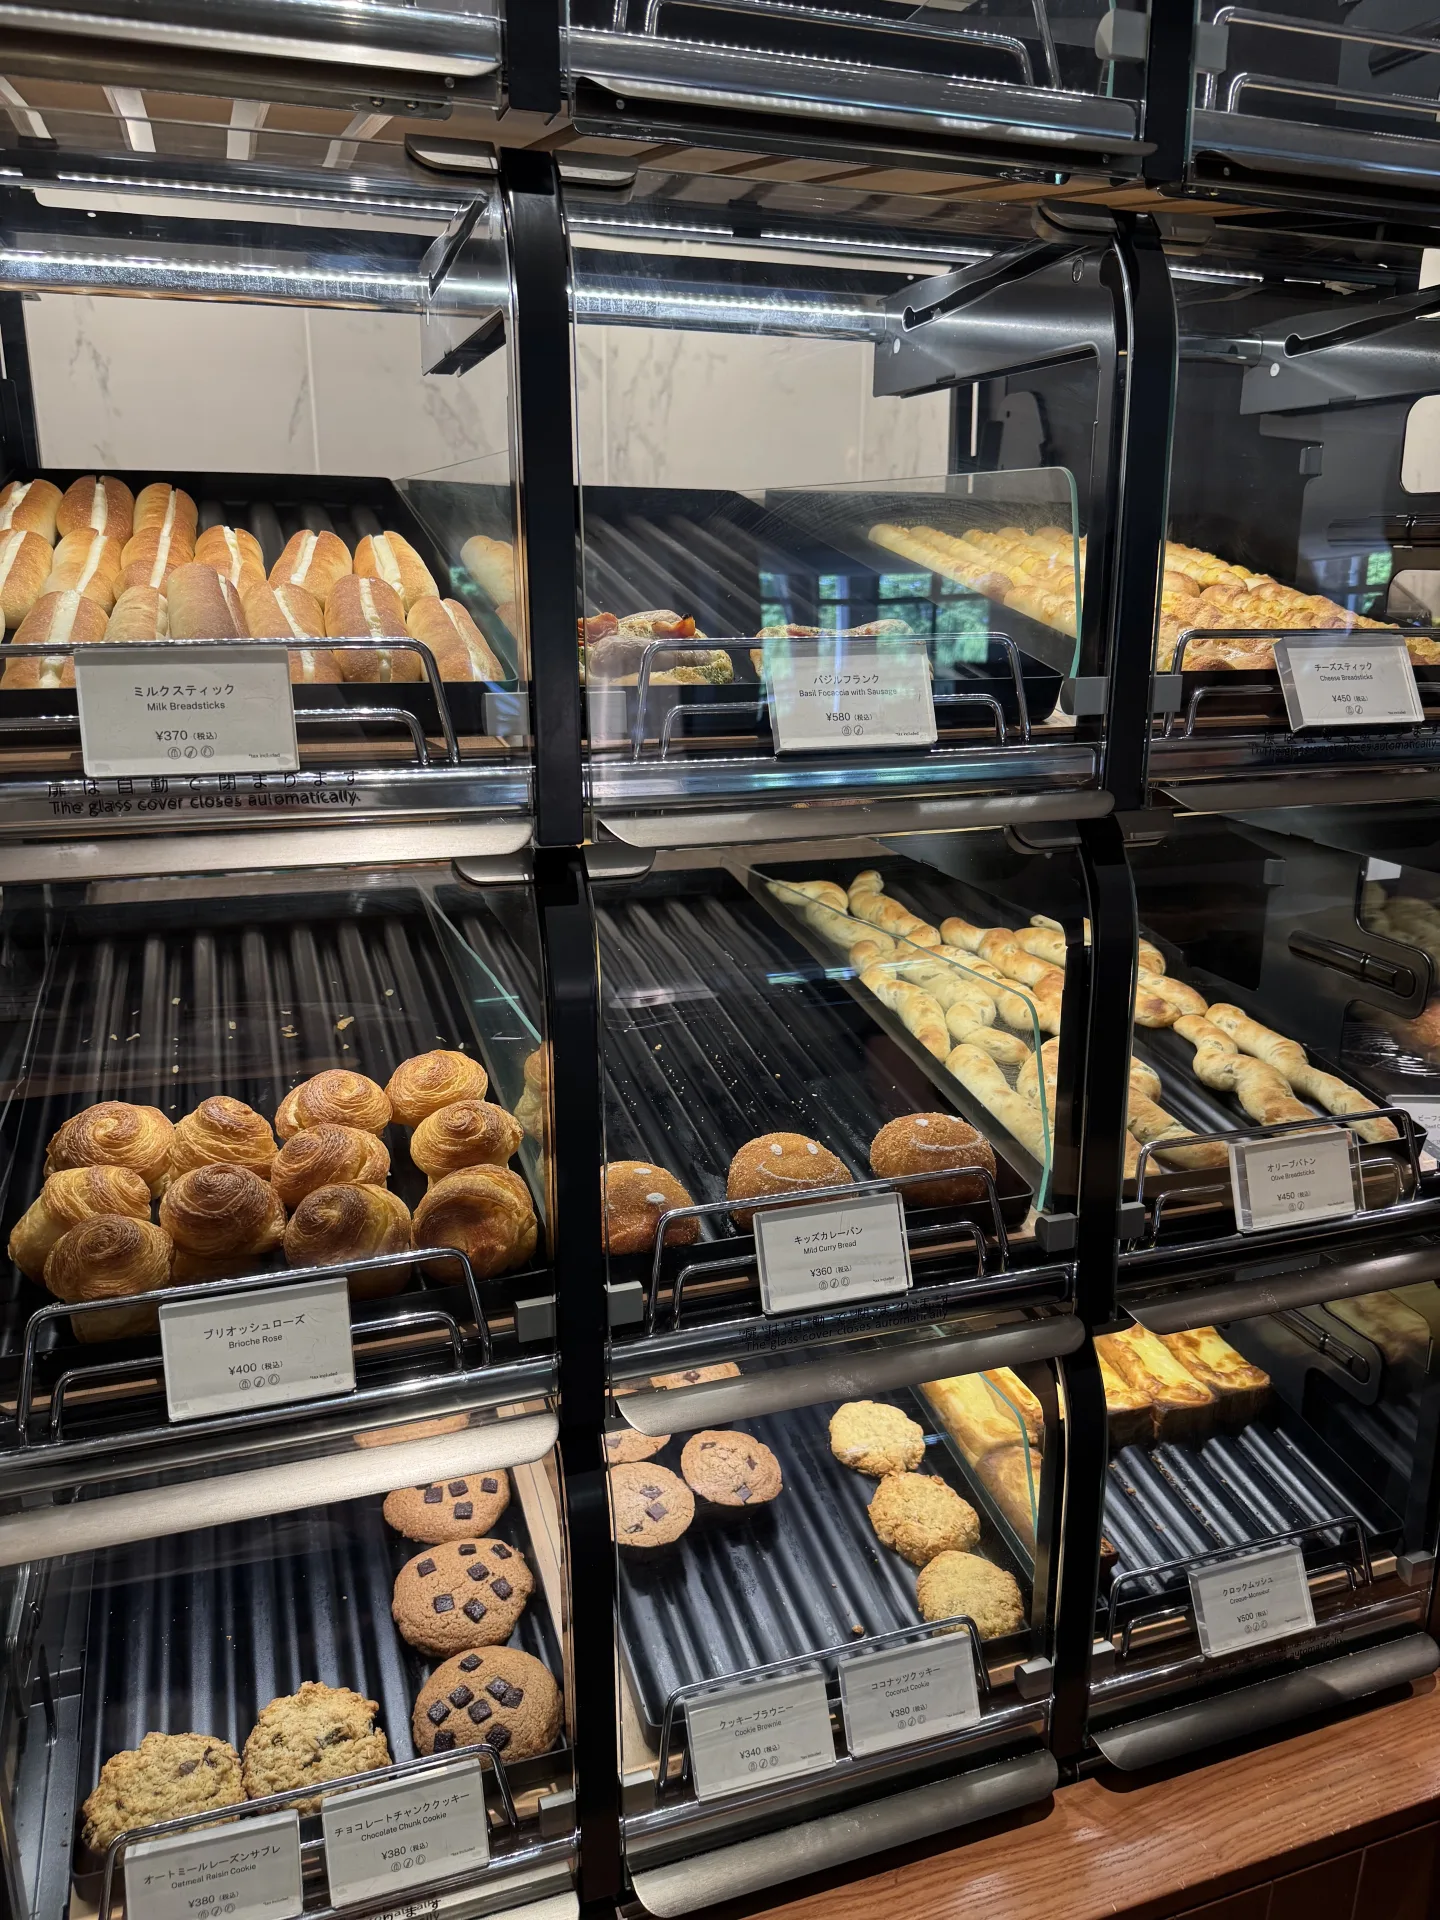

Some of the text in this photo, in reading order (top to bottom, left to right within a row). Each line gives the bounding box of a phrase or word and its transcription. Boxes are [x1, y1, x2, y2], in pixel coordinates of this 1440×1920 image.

[813, 674, 880, 685] バジルフランク
[1341, 674, 1373, 682] Breadsticks
[134, 683, 234, 697] ミルクスティック
[799, 689, 817, 697] Basil
[818, 689, 850, 697] Focaccia
[867, 688, 897, 696] Sausage
[147, 701, 225, 711] Milk Breadsticks
[826, 712, 851, 721] ¥580
[155, 730, 188, 741] ¥370
[49, 800, 83, 815] The
[89, 799, 132, 817] glass
[138, 797, 183, 812] cover
[190, 794, 242, 808] closes
[1267, 1158, 1316, 1173] オリーブバトン
[1271, 1169, 1316, 1182] Olive Breadsticks
[1277, 1191, 1295, 1201] ¥450
[803, 1240, 857, 1255] Mild Curry Bread
[810, 1267, 833, 1277] ¥360
[203, 1314, 306, 1340] ブリオッシュローズ
[228, 1334, 283, 1349] Brioche Rose
[746, 1340, 769, 1351] The
[770, 1336, 799, 1350] glass
[802, 1329, 833, 1341] cover
[837, 1323, 871, 1336] closes
[228, 1363, 257, 1376] ¥400
[1223, 1577, 1274, 1596] クロックムッシュ
[1237, 1612, 1254, 1623] ¥500
[871, 1667, 941, 1690] ココナッツクッキー
[885, 1680, 930, 1698] Coconut Cookie
[719, 1705, 794, 1730] クッキーブラウニー
[889, 1706, 910, 1718] ¥380
[734, 1720, 782, 1737] Cookie Brownie
[739, 1747, 761, 1759] ¥340
[334, 1793, 470, 1838] チョコレートチャンククッキー
[361, 1812, 447, 1842] Chocolate Chunk Cookie
[381, 1846, 407, 1861] ¥380
[144, 1845, 281, 1885] オートミールレーズンサブレ
[171, 1863, 257, 1889] Oatmeal Raisin Cookie
[188, 1895, 215, 1909] ¥380
